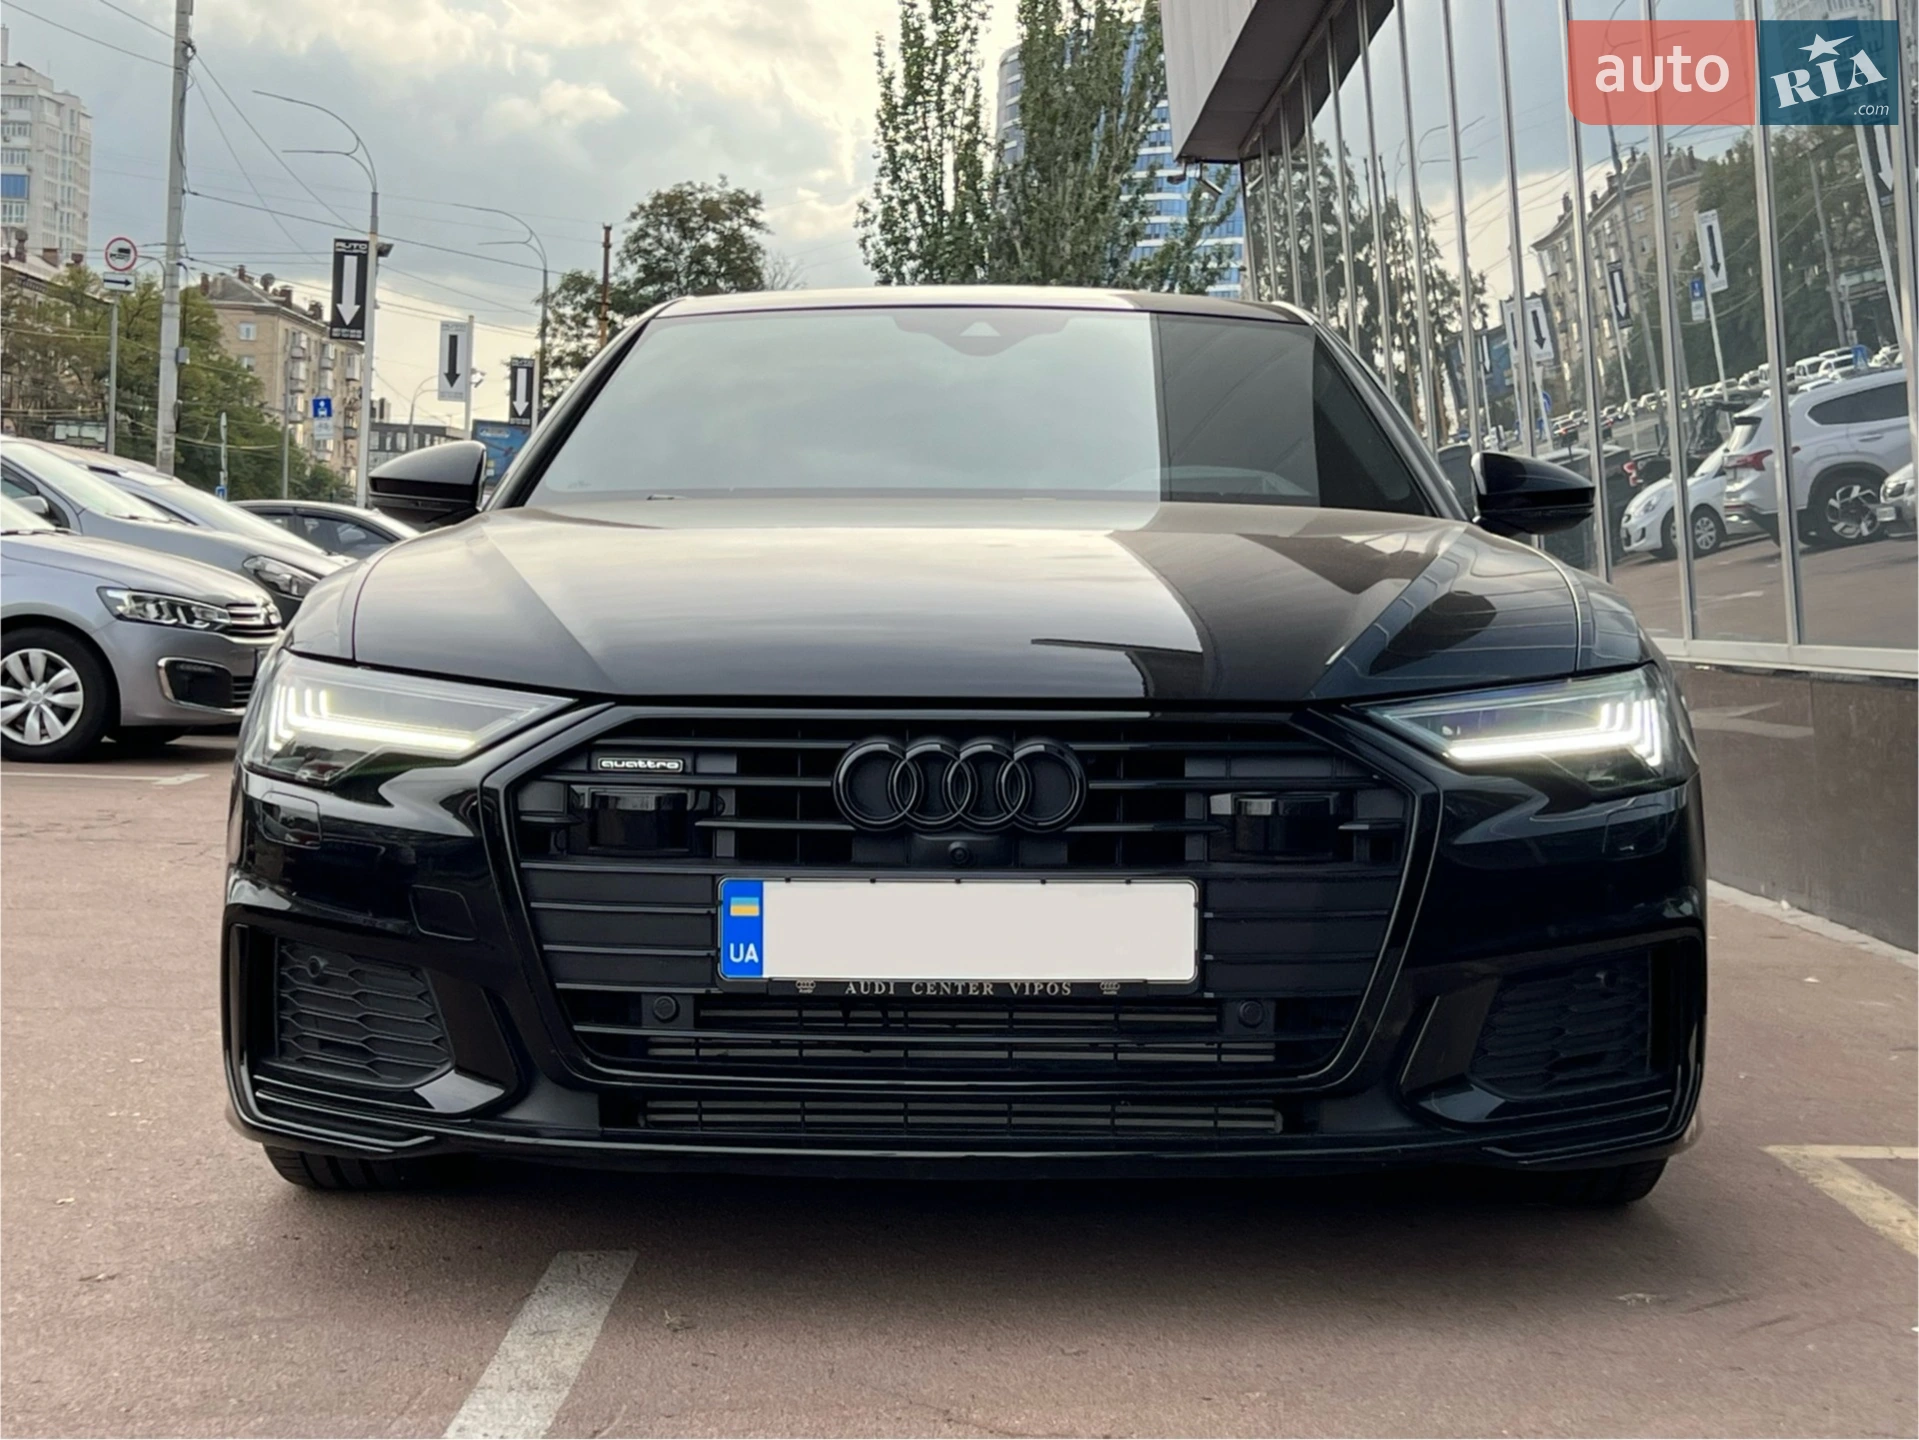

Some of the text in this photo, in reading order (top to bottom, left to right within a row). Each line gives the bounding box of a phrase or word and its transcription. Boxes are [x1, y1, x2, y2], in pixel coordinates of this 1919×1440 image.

[601, 760, 679, 769] quattro
[729, 942, 760, 963] UA
[844, 981, 1073, 995] AUDI CENTER VIPOS
